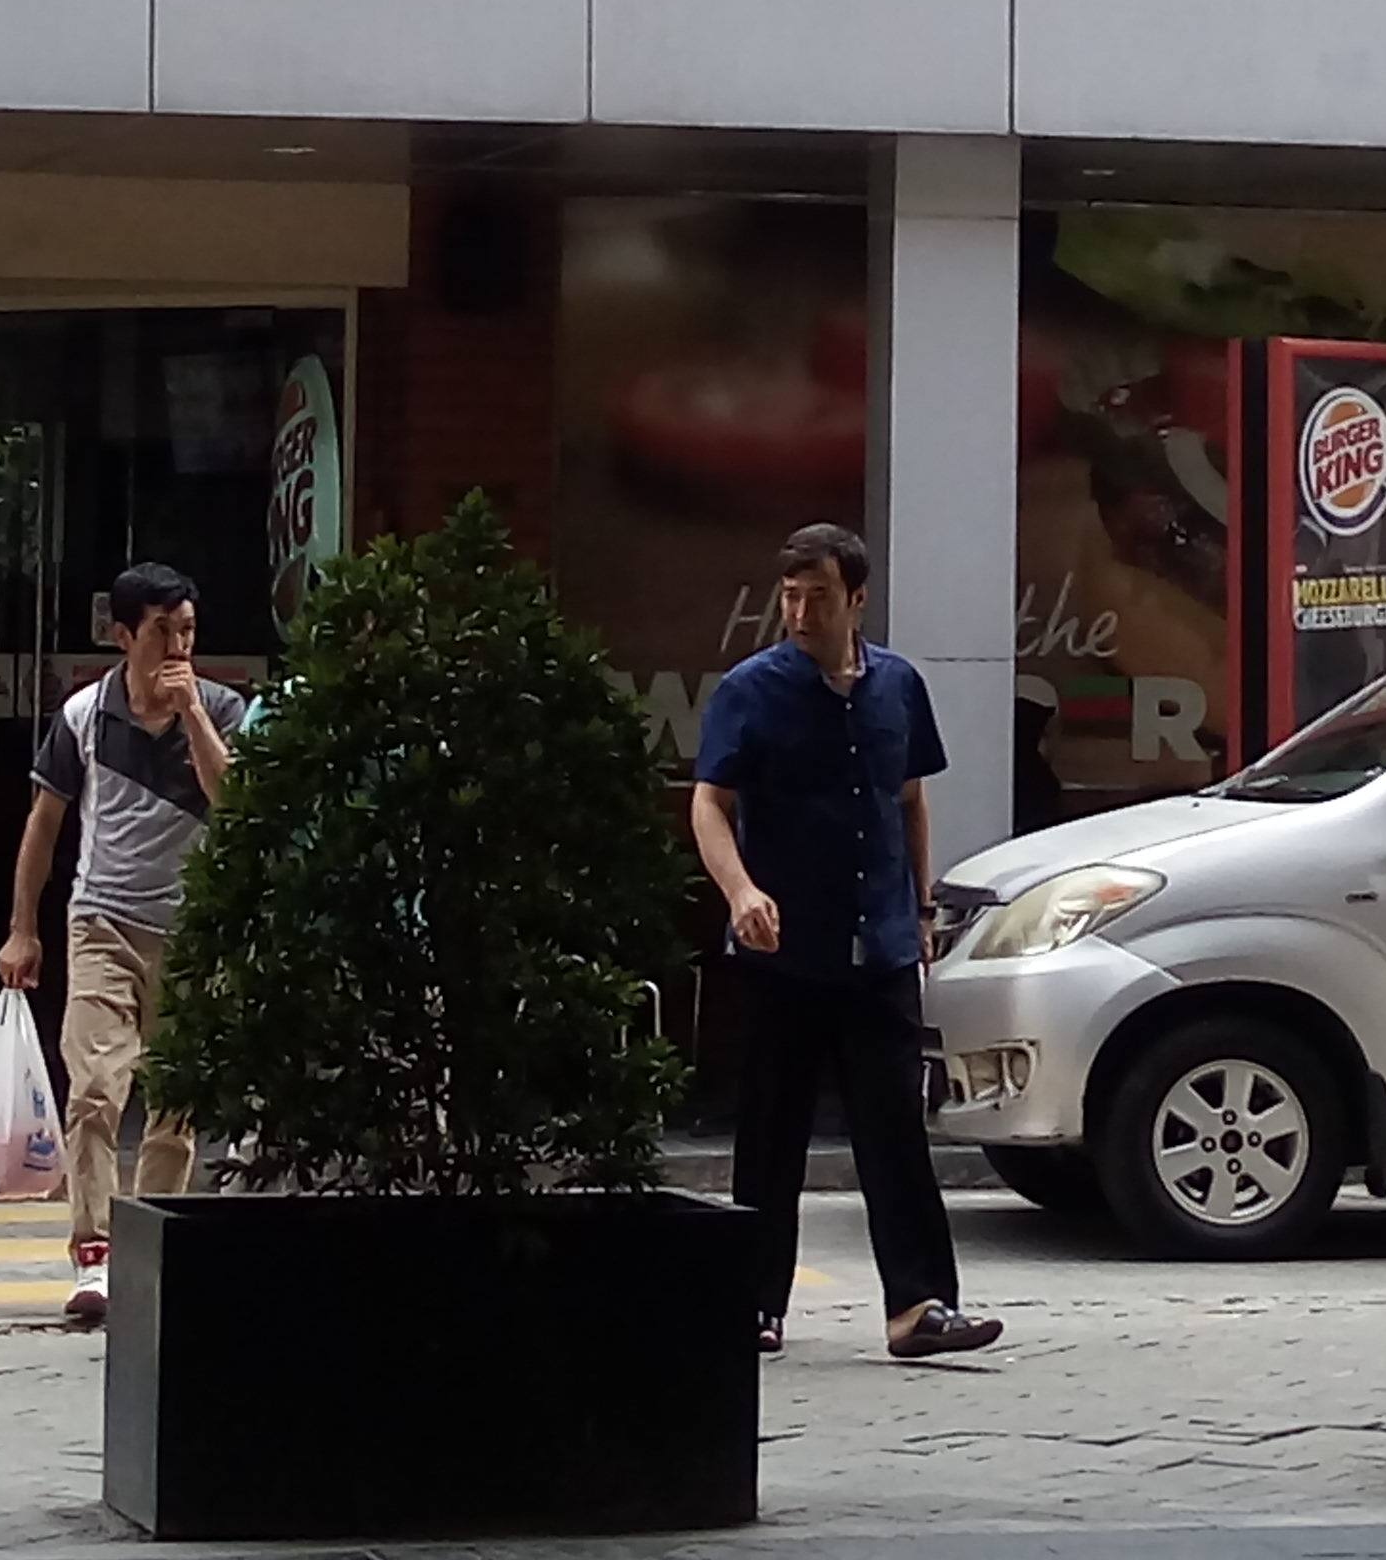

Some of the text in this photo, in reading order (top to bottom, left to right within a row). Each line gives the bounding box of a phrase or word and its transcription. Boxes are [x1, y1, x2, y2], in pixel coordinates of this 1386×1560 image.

[1314, 418, 1381, 465] BURGER
[1316, 442, 1384, 498] KING
[1014, 571, 1121, 659] the
